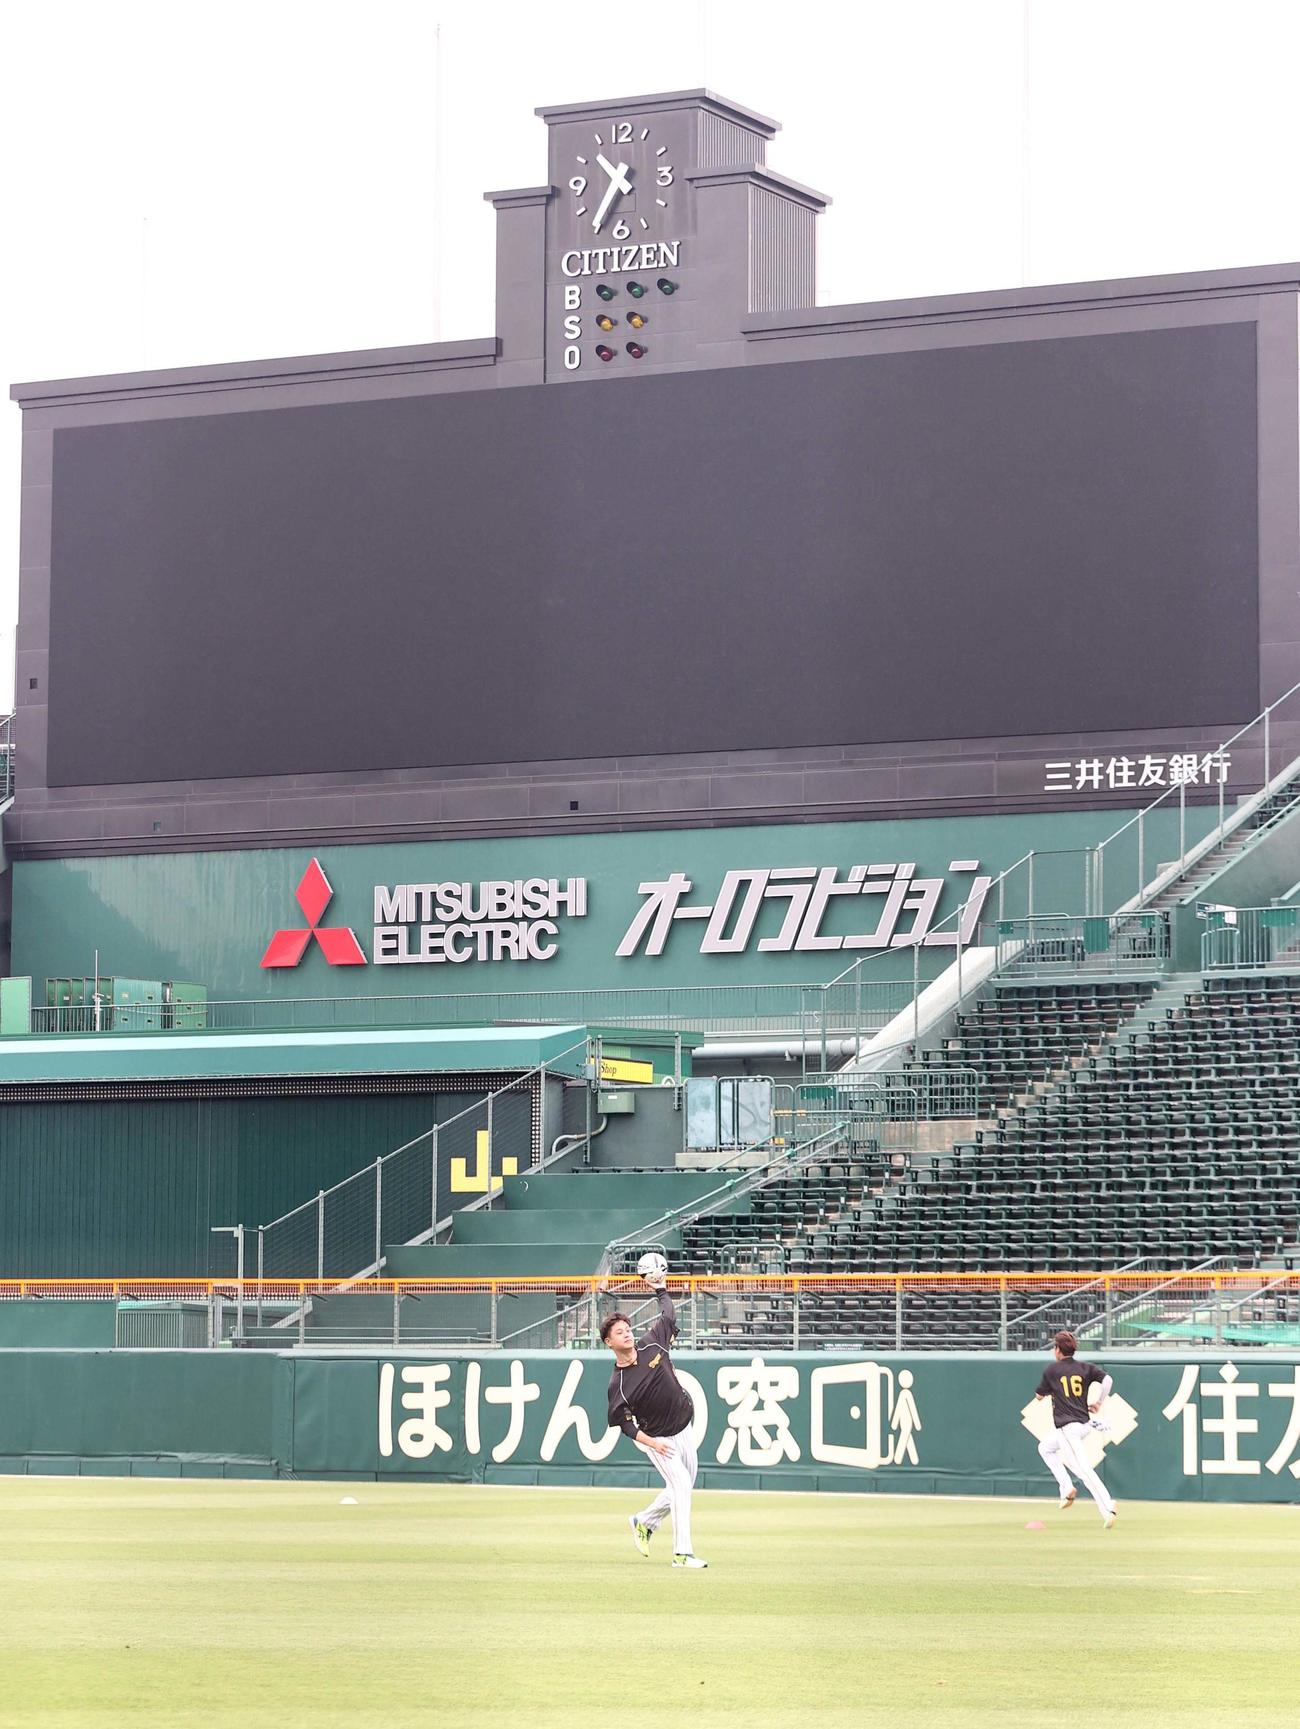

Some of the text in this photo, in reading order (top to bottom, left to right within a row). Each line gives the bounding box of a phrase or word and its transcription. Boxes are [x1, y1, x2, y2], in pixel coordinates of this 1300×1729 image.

[611, 122, 633, 143] 12
[568, 176, 587, 197] 9
[656, 166, 674, 187] 3
[612, 220, 630, 240] 6
[561, 241, 681, 277] CITIZEN
[564, 285, 582, 311] B
[564, 315, 582, 340] S
[1044, 752, 1232, 791] 三井住友銀行
[374, 877, 588, 924] MITSUBISHI
[615, 860, 992, 956] オーロラビジョン
[374, 920, 559, 964] ELECTRIC
[1060, 1375, 1083, 1398] 16
